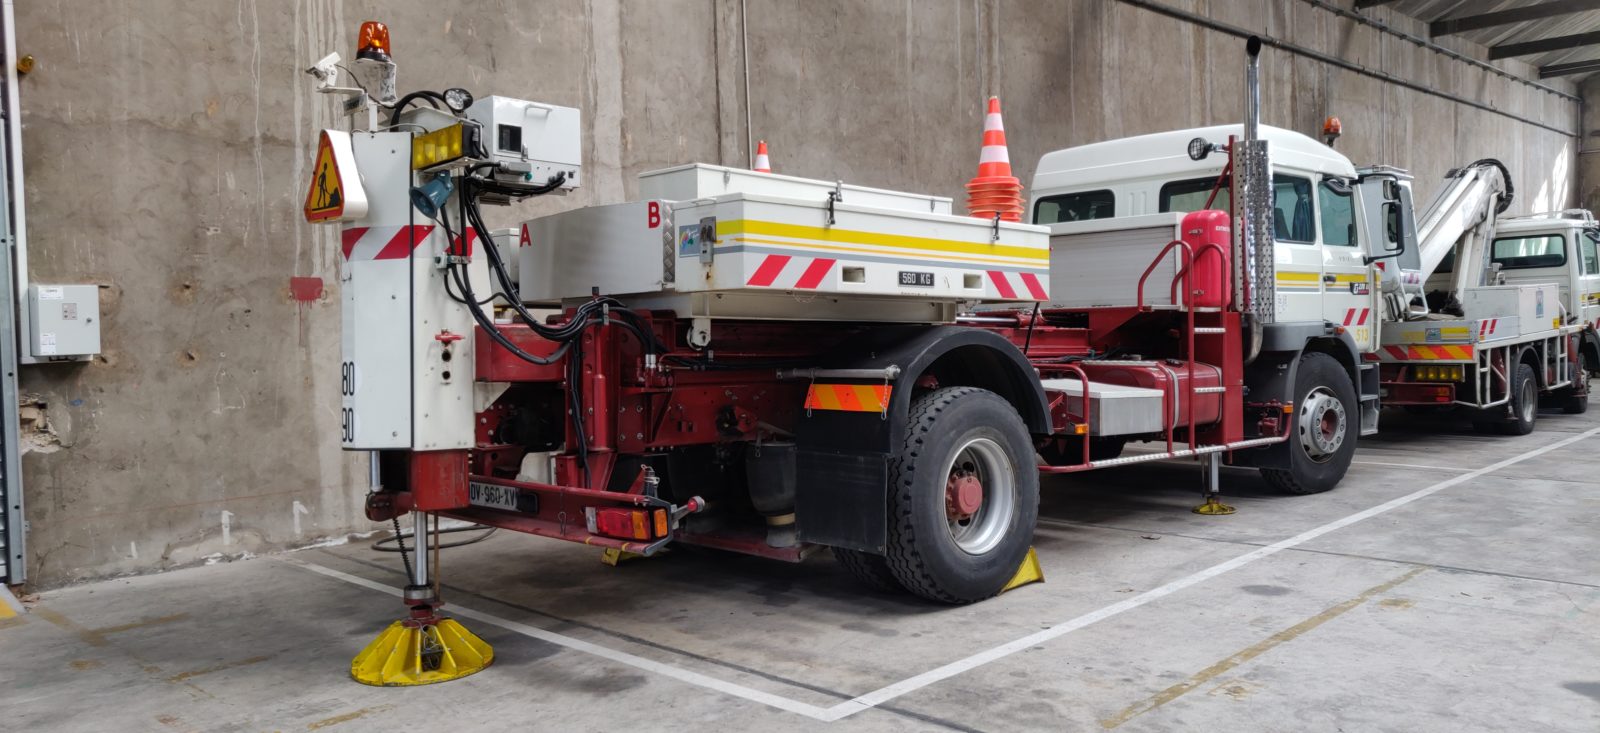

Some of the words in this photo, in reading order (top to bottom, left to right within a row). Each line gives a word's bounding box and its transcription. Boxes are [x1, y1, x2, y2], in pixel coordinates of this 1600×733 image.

[648, 201, 661, 229] B
[519, 223, 532, 248] A
[902, 272, 917, 285] 560
[920, 273, 931, 285] KG
[342, 361, 355, 396] 80
[342, 407, 354, 443] 90
